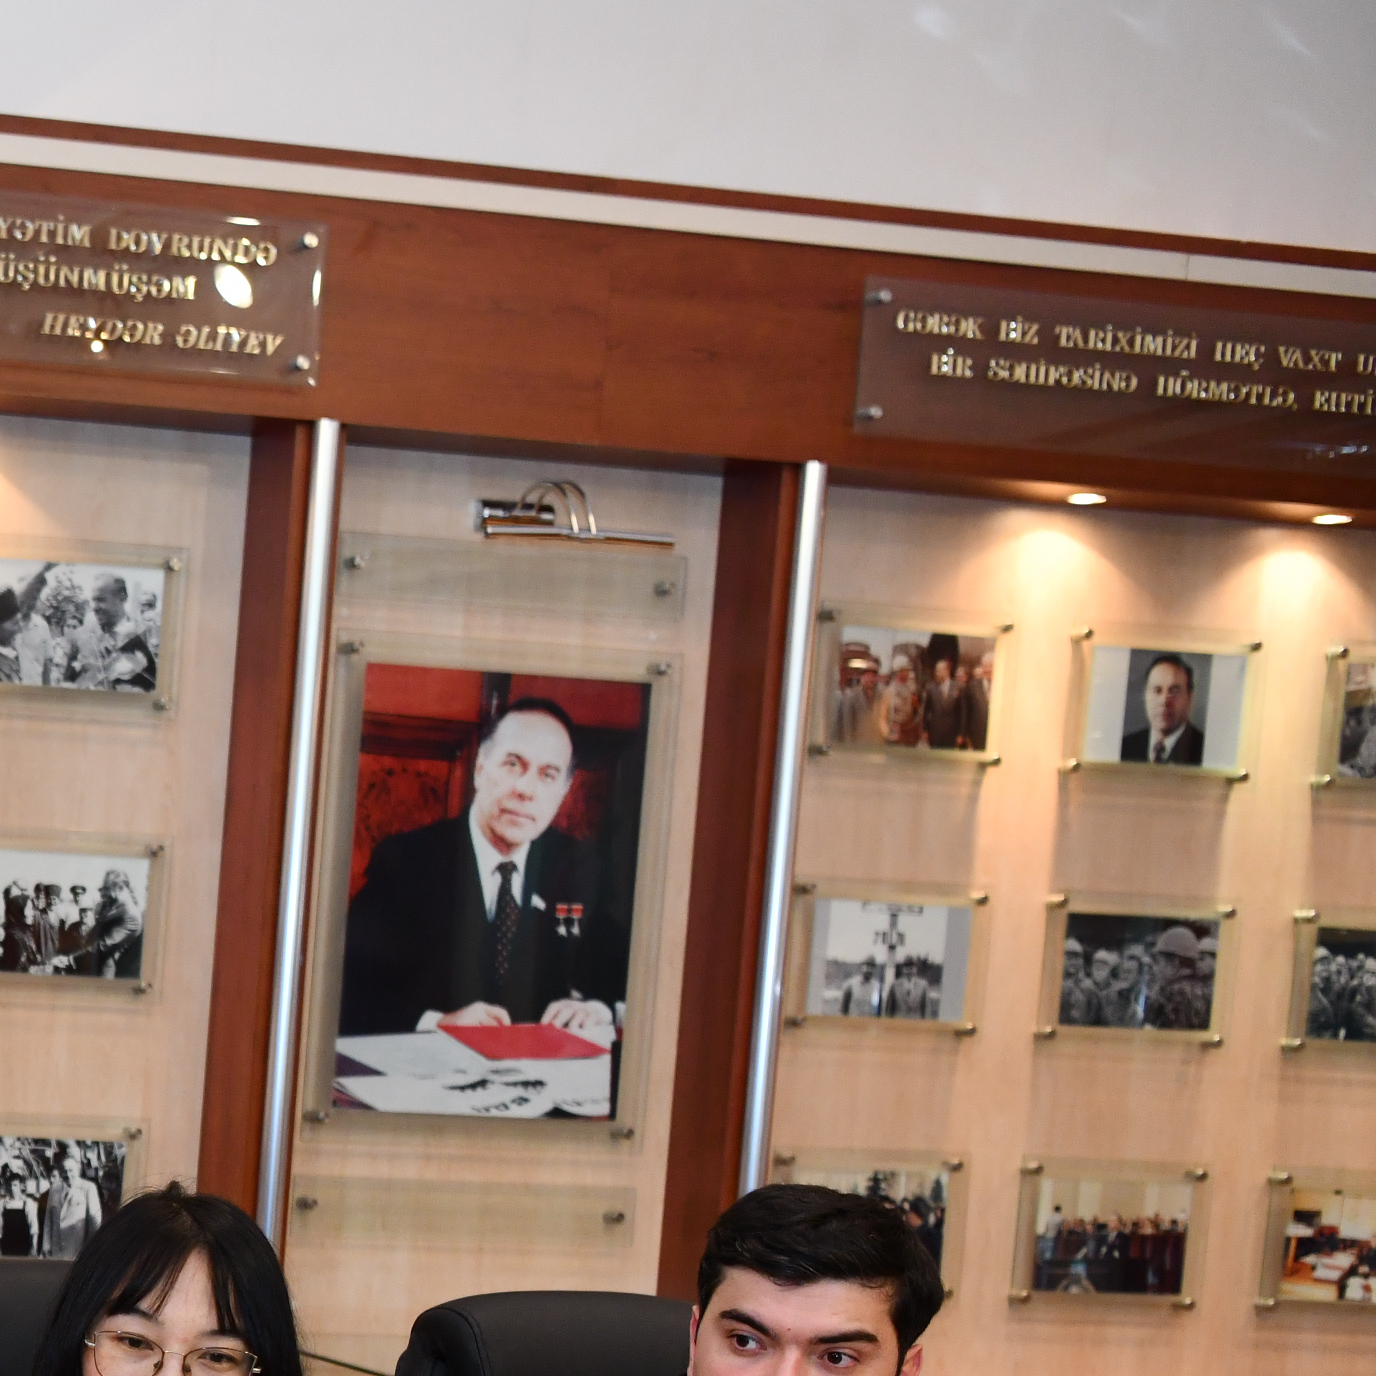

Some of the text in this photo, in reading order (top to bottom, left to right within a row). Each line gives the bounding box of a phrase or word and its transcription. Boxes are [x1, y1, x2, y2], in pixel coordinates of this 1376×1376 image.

[41, 311, 284, 356] HEYDƏR ƏLİYEV
[1278, 345, 1342, 373] VAXT
